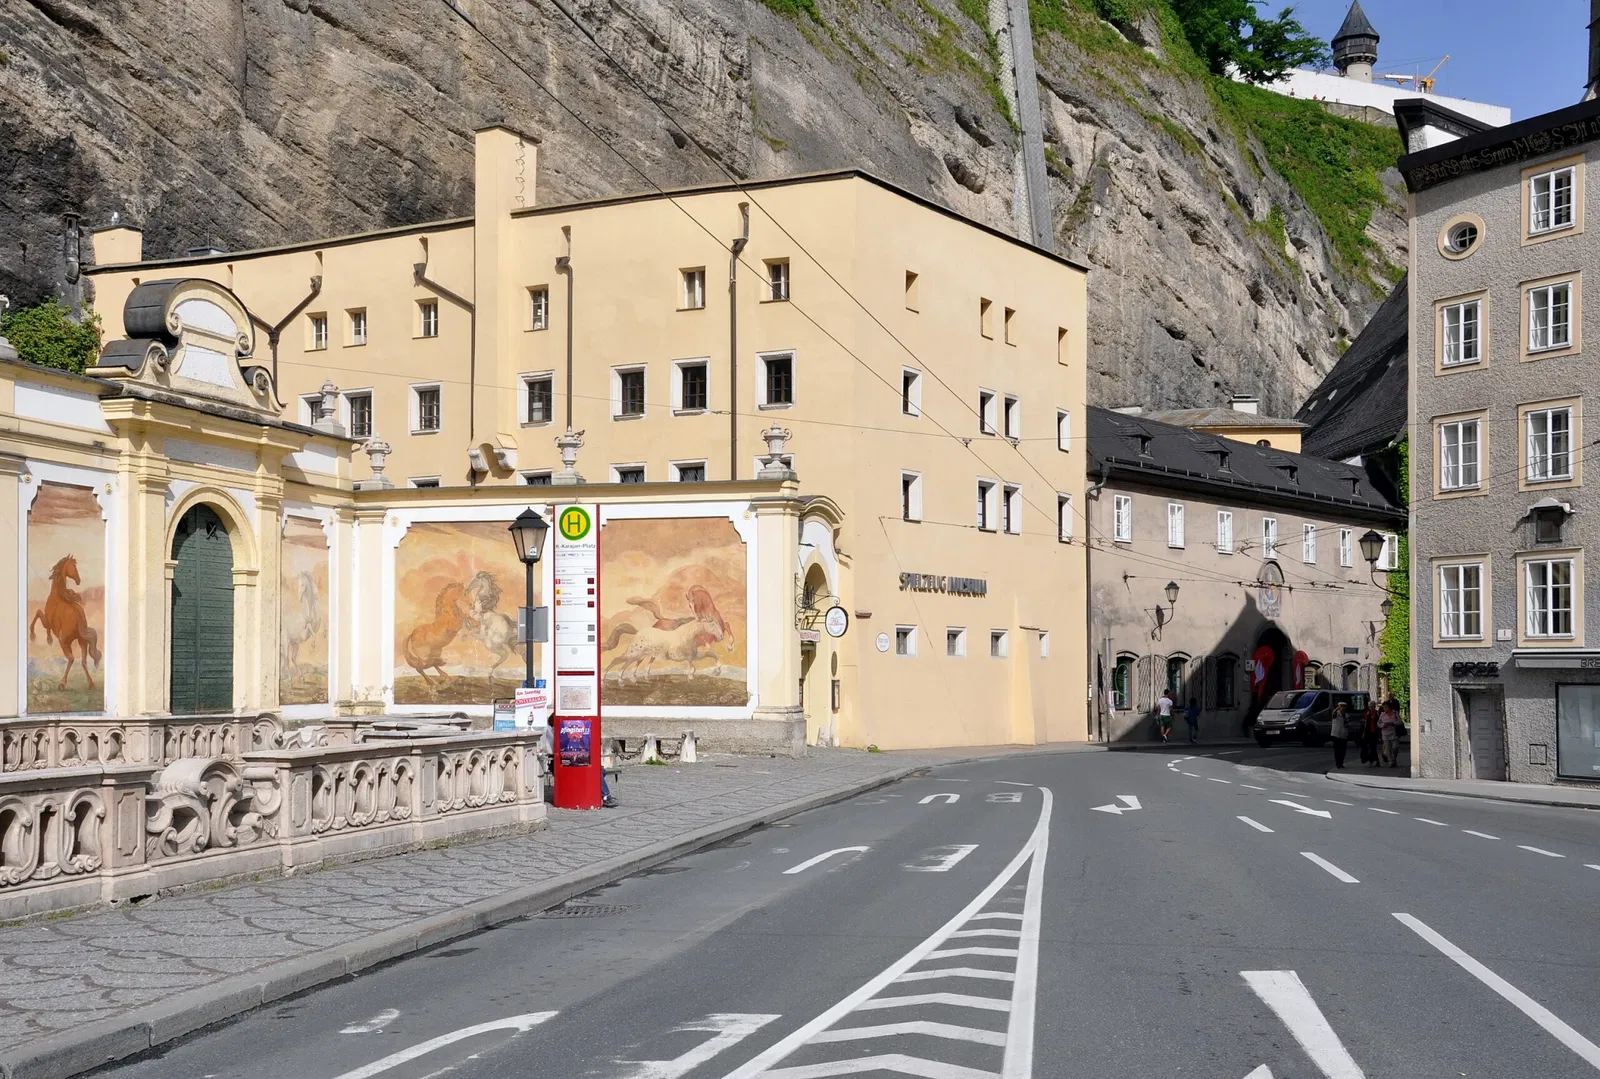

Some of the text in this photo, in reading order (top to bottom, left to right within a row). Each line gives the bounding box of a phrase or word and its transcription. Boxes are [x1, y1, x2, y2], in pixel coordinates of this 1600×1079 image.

[568, 514, 580, 533] H
[899, 572, 947, 594] SPIELZEUG
[1452, 661, 1500, 678] BREE
